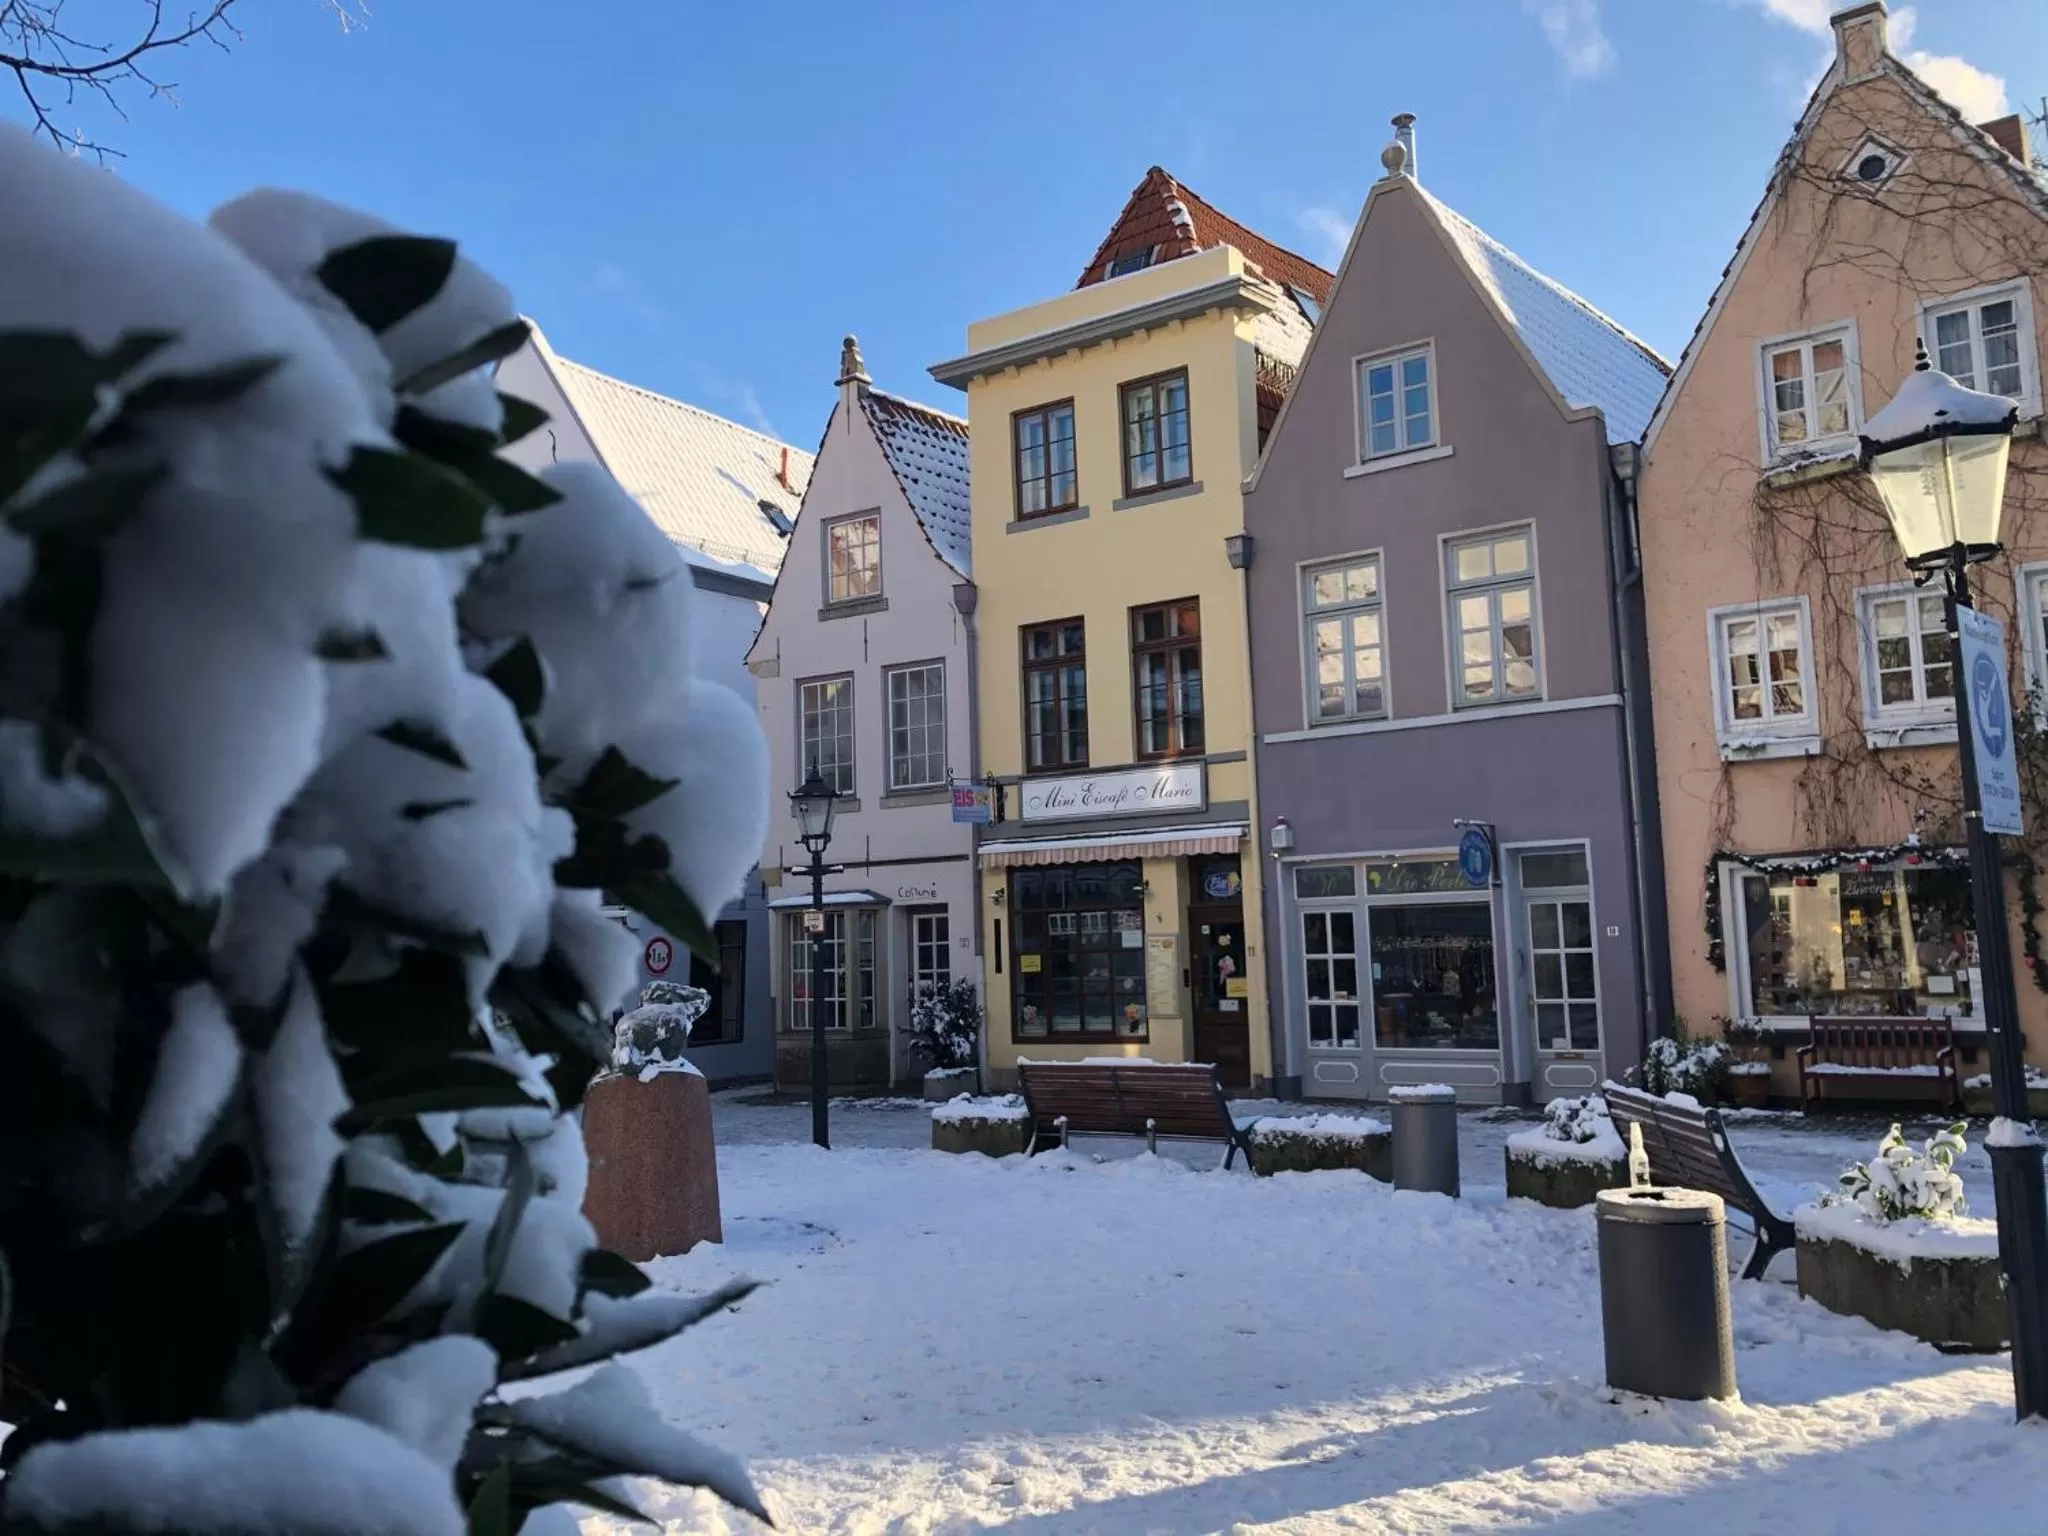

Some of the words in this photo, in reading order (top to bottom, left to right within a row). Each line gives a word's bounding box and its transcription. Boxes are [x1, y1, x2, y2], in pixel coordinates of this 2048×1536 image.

[953, 788, 975, 807] EIS
[1029, 785, 1077, 810] Mini
[1081, 782, 1129, 809] Eiscafé
[1134, 776, 1193, 801] Mario
